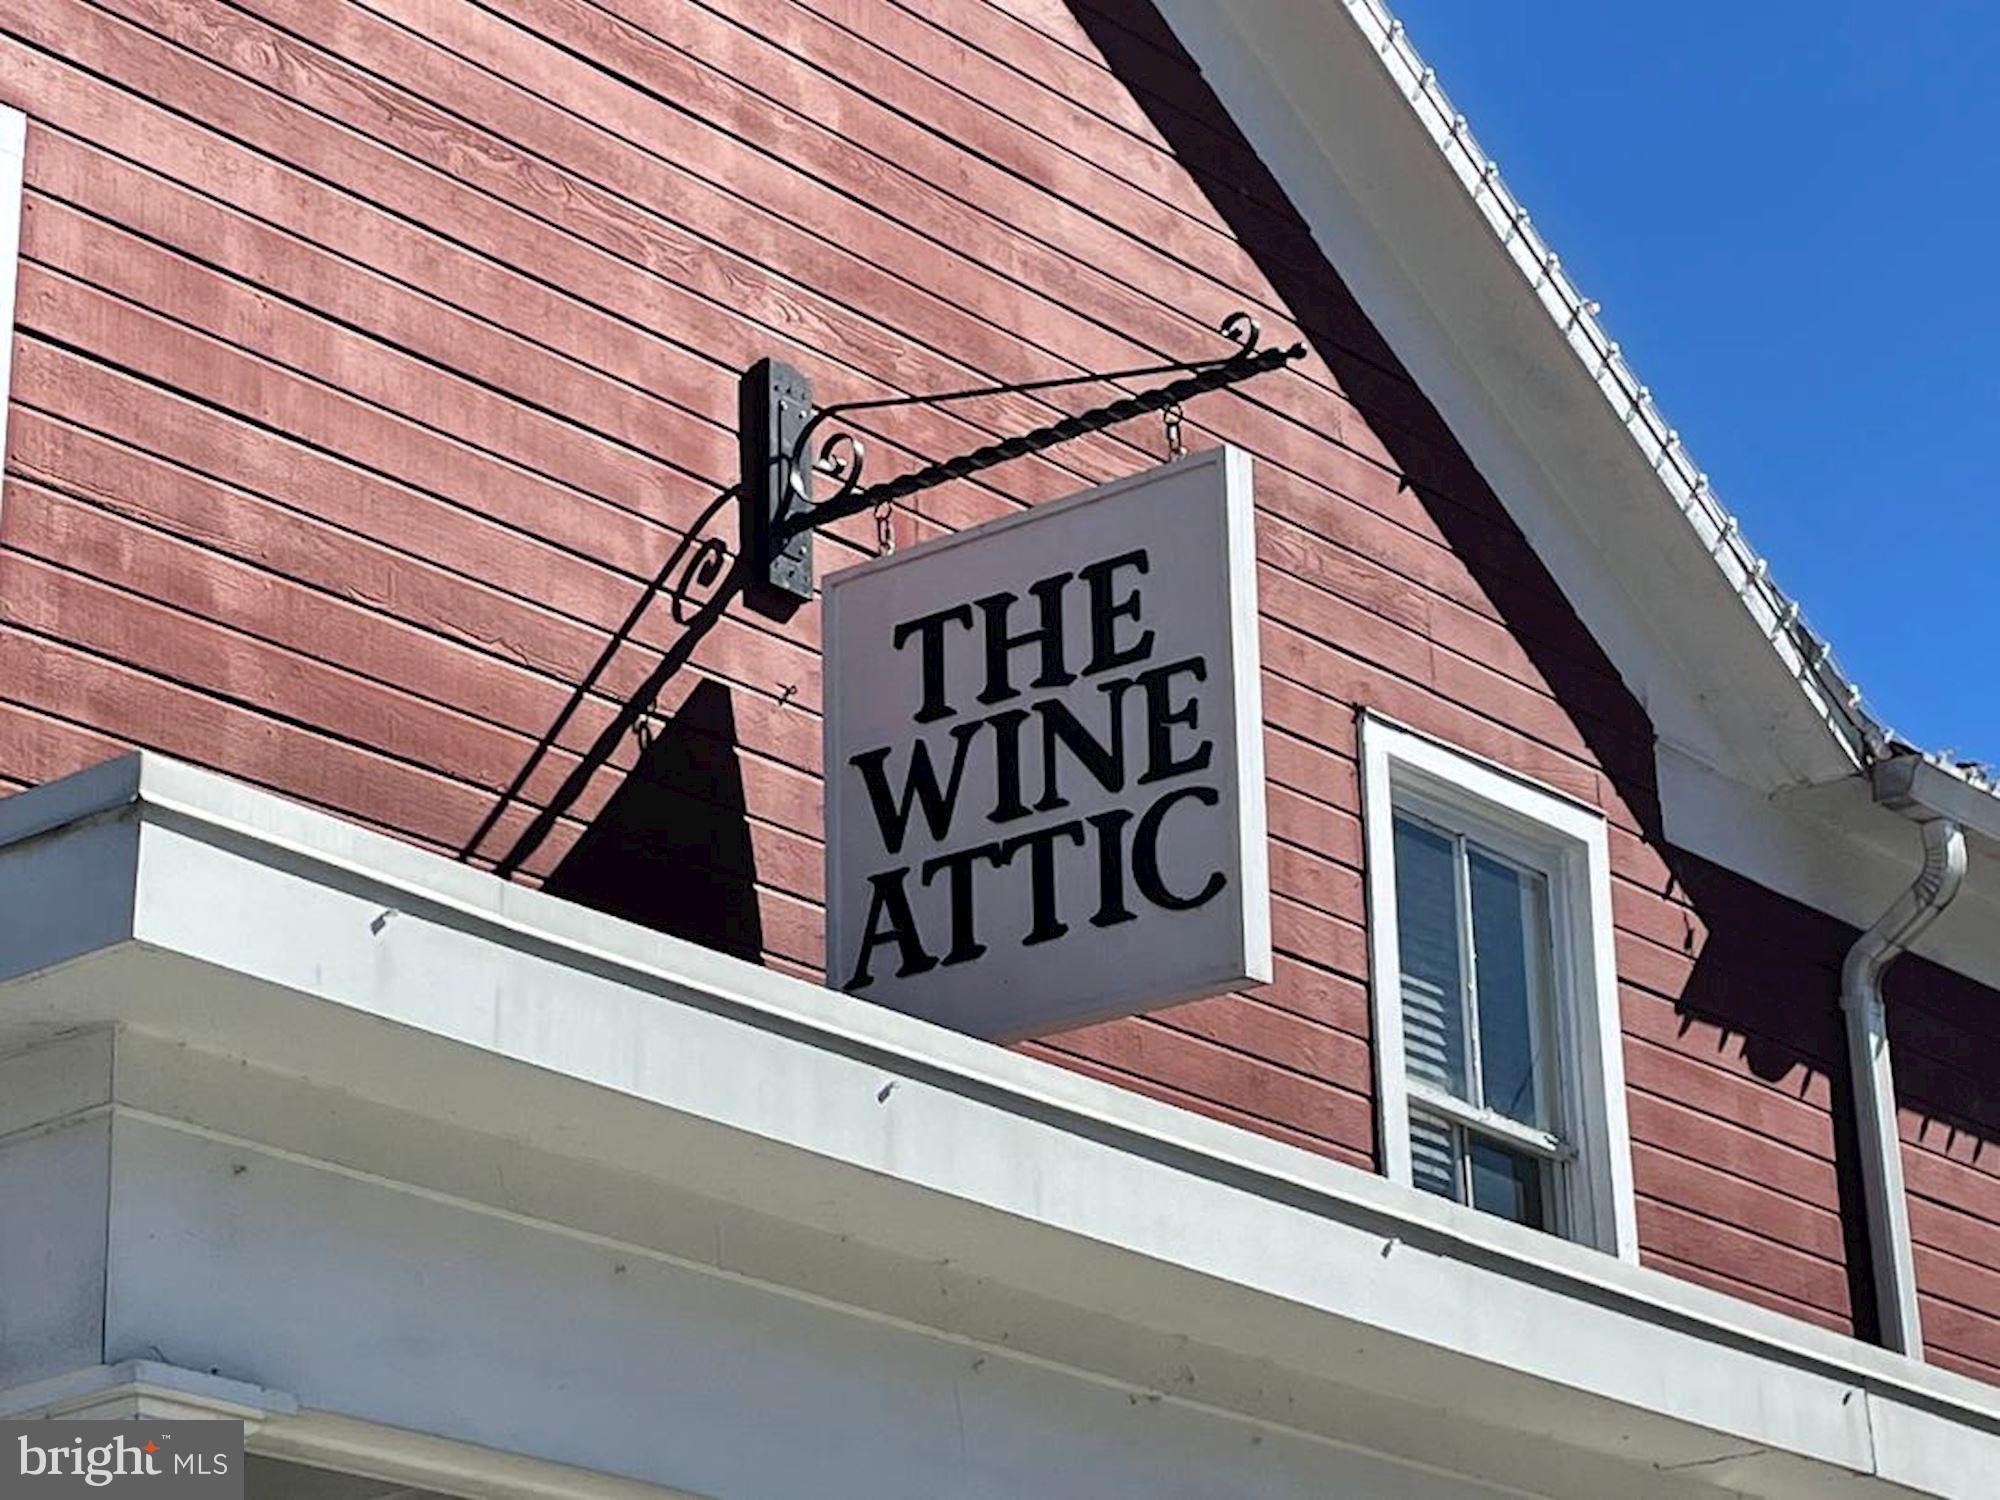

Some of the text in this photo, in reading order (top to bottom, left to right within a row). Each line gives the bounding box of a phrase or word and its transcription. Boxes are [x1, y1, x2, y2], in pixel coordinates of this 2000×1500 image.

[893, 548, 1155, 725] THE
[848, 655, 1213, 855] WINE
[843, 786, 1227, 991] ATTIC
